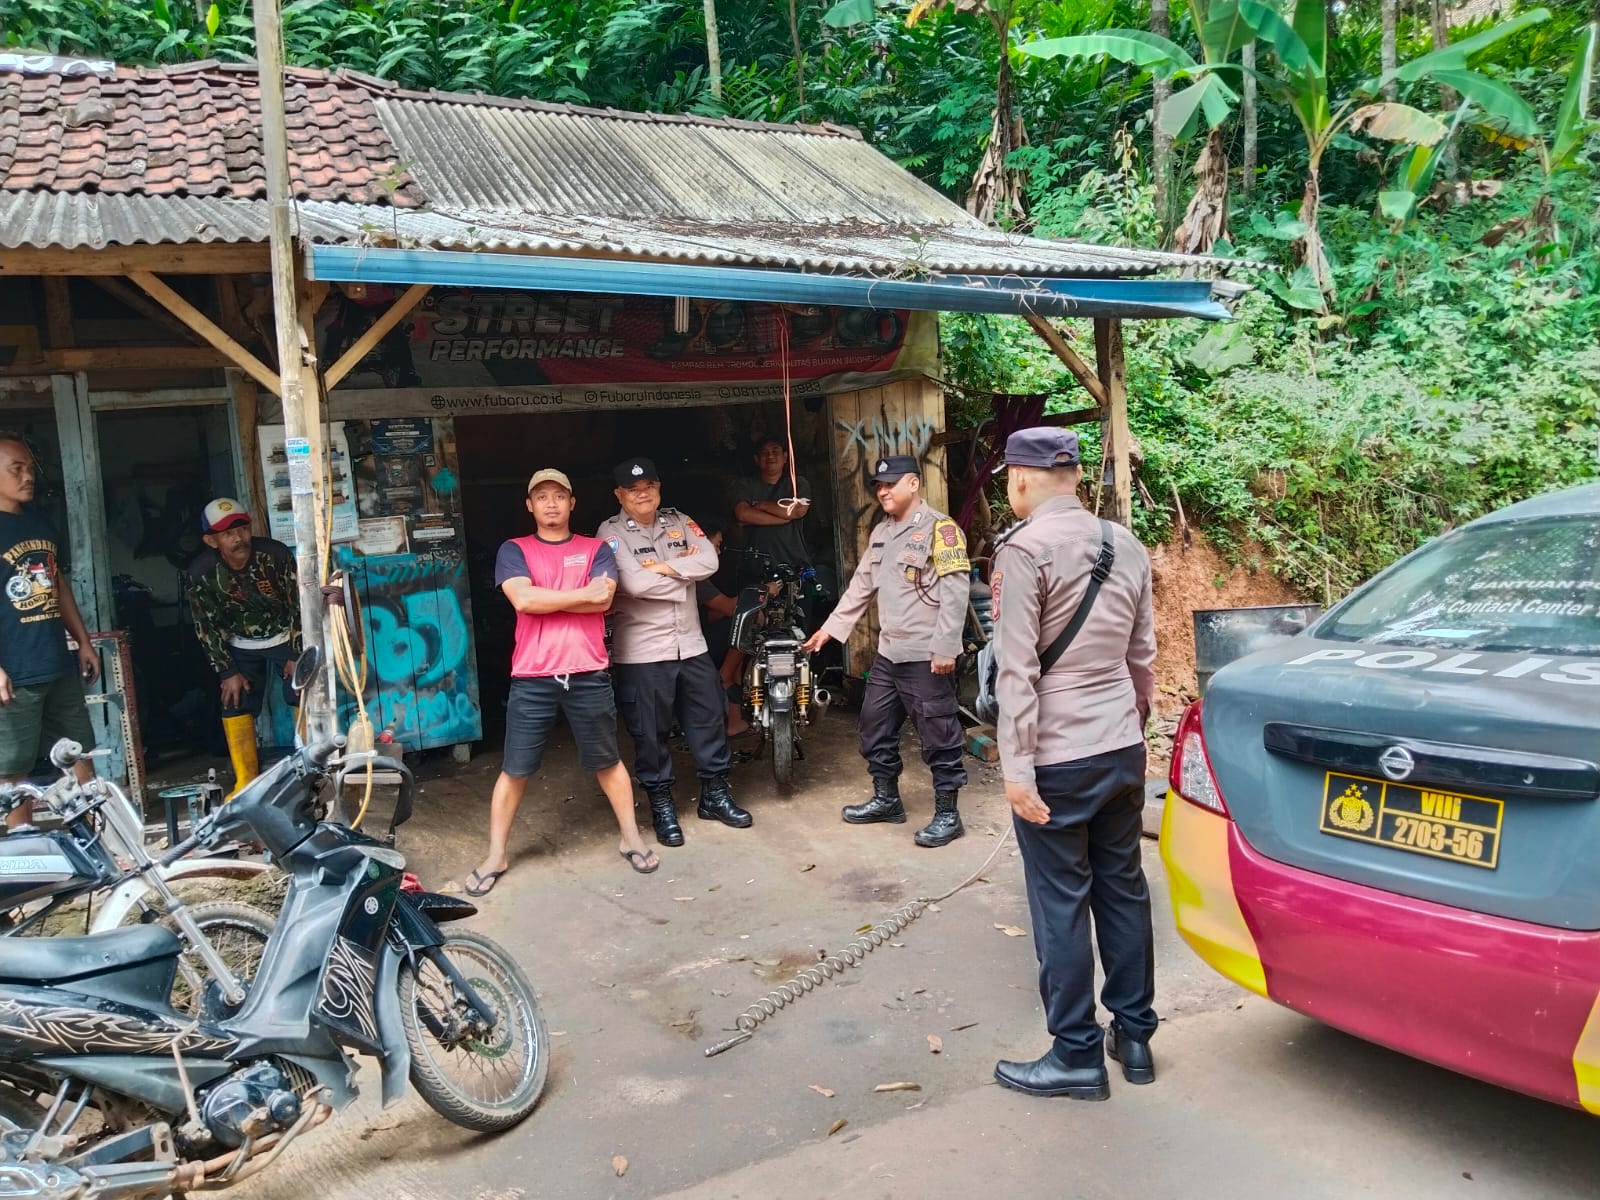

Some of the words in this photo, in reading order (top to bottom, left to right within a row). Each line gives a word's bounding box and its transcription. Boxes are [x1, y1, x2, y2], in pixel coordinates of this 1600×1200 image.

[433, 294, 625, 335] STREET
[431, 338, 625, 361] PERFORMANCE
[446, 392, 563, 409] www.fuboru.co.id
[905, 542, 928, 553] POLRI
[1469, 580, 1574, 590] BANTUAN
[1447, 599, 1522, 614] Contact
[1522, 599, 1593, 616] Center
[1420, 791, 1462, 821] VIII
[1392, 817, 1484, 859] 2703-56
